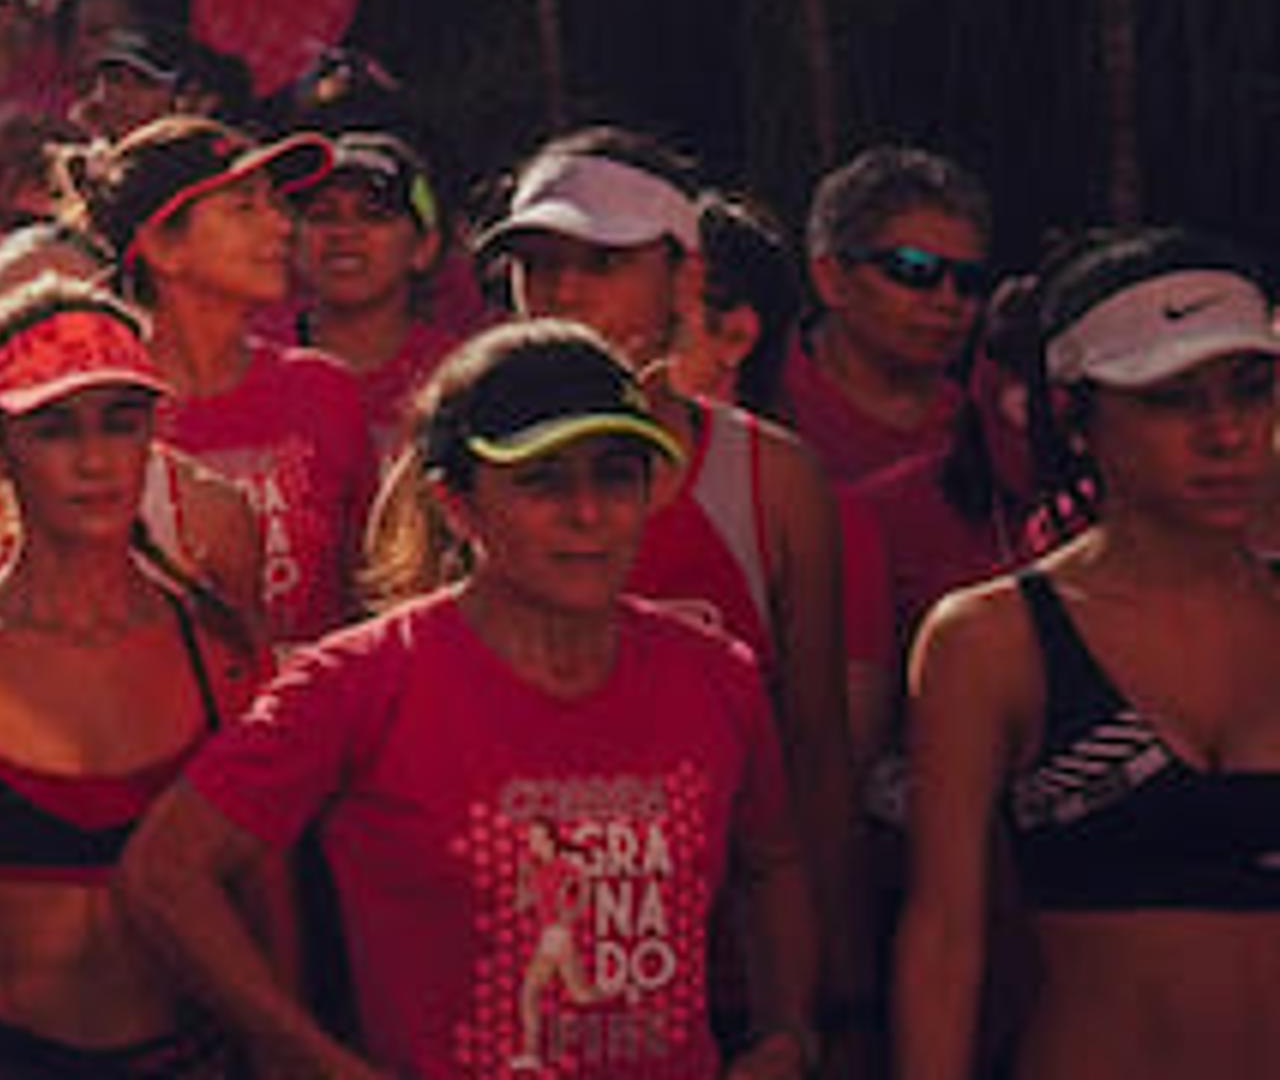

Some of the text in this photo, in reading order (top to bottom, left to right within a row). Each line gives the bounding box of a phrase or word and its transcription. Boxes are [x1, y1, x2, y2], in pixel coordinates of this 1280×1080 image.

[572, 823, 672, 877] GRA
[595, 880, 670, 938] NA
[596, 940, 678, 994] DO
